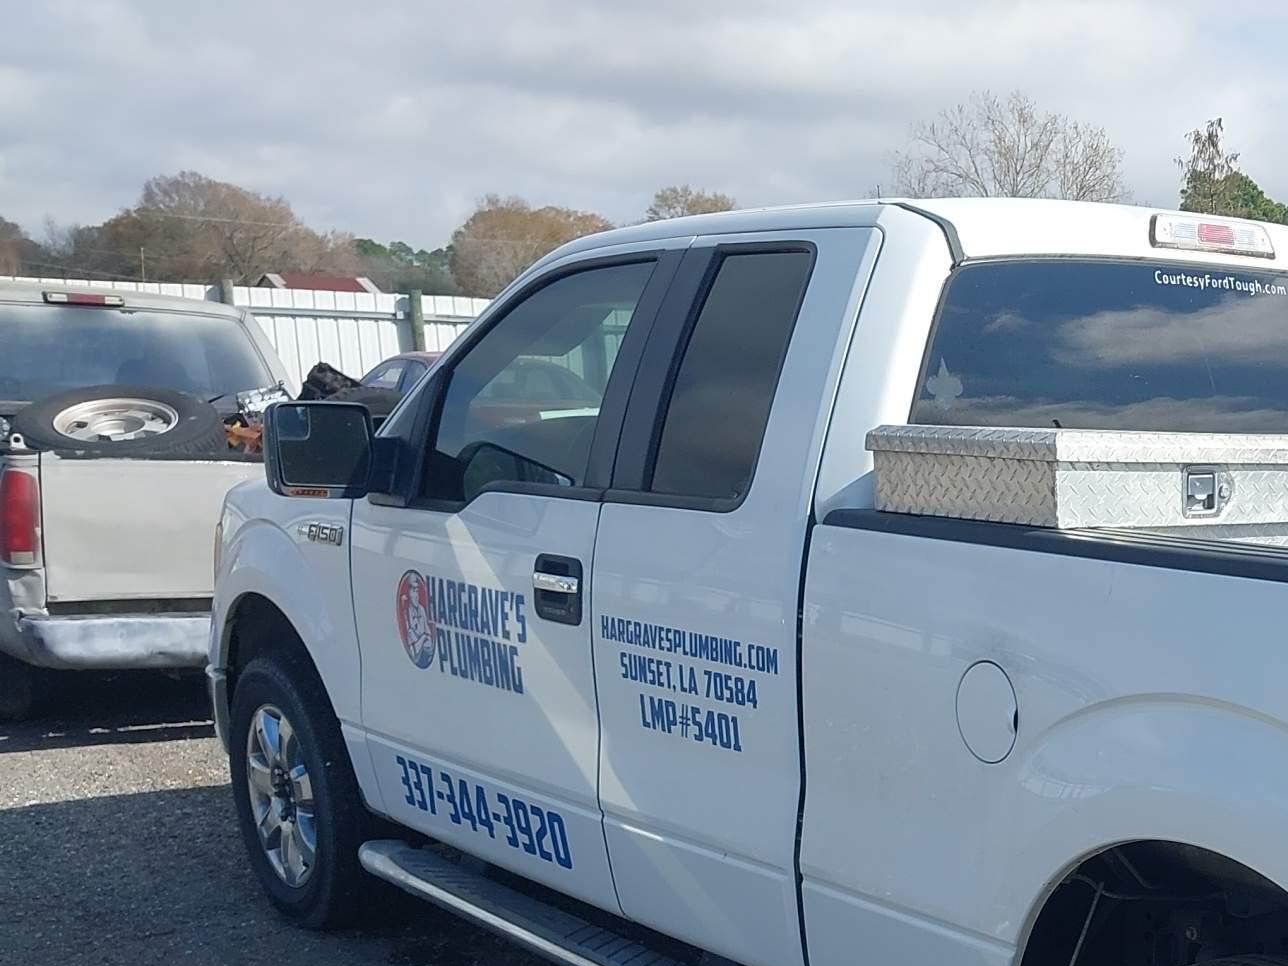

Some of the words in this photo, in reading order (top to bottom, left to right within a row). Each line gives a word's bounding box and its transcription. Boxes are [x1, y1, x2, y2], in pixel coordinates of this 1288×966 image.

[1154, 270, 1287, 296] CourtesyFordTough.com
[425, 575, 526, 643] HARGRAVE'S
[436, 627, 524, 695] PLUMBING
[600, 614, 778, 675] HARGRAVESPLUMBING.COM
[620, 651, 677, 693] SUNSET,
[678, 663, 699, 696] LA
[703, 669, 758, 709] 70584
[639, 693, 743, 753] LMP#5401
[396, 755, 573, 870] 337-344-3920
